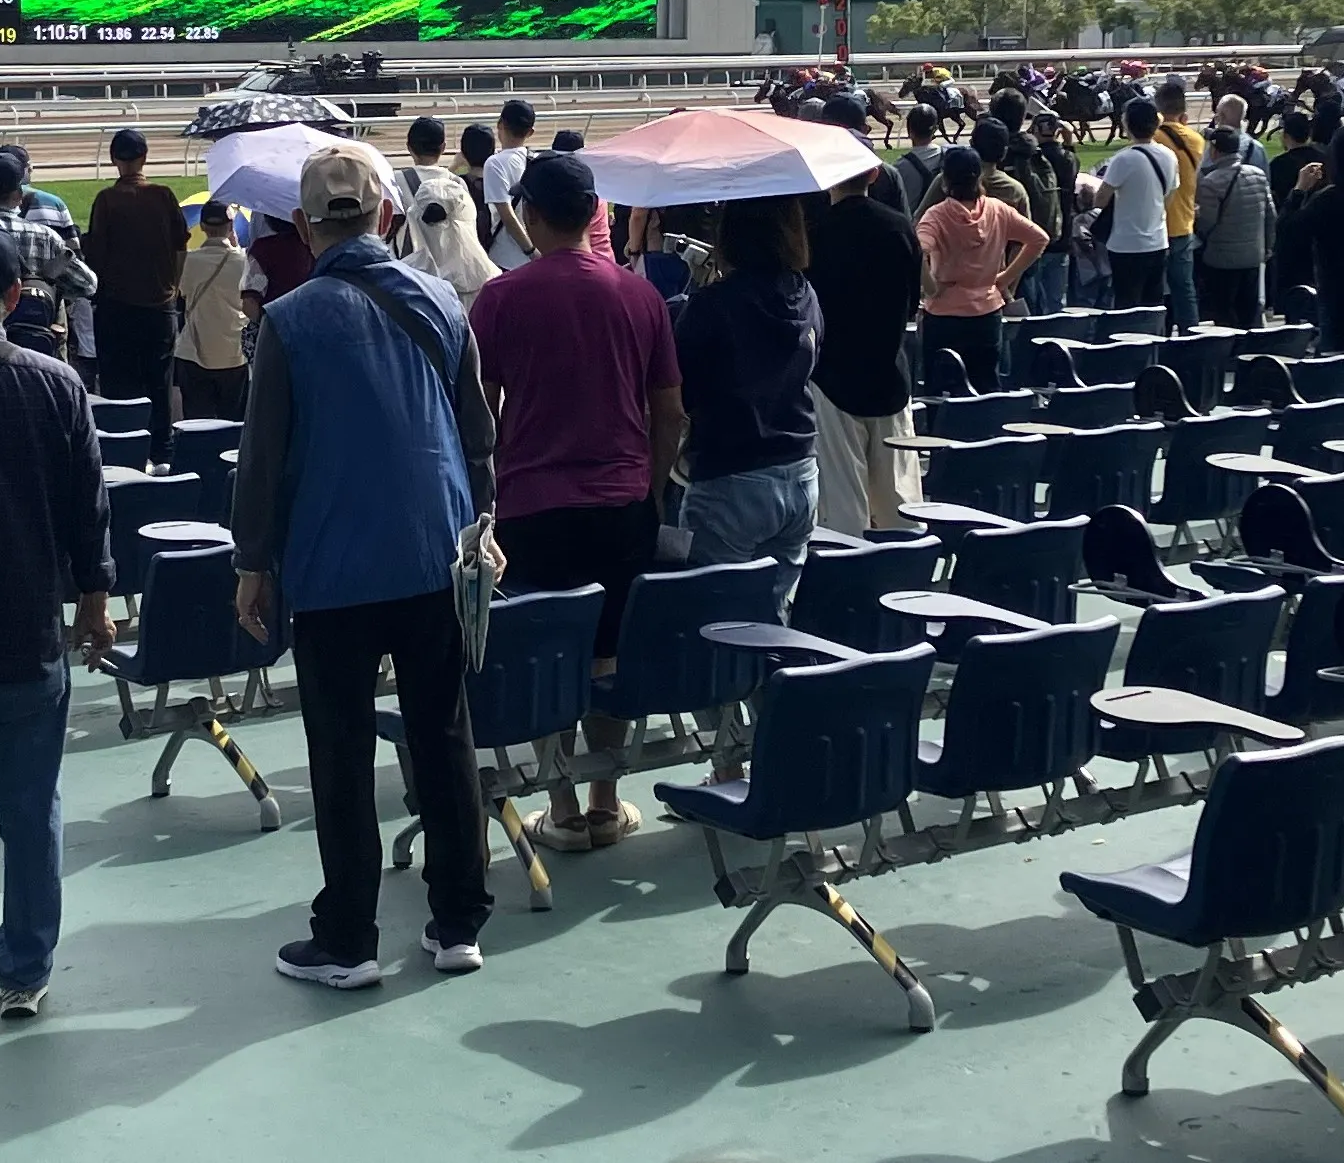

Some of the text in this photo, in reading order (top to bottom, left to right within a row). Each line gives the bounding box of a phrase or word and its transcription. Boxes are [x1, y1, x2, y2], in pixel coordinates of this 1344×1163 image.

[33, 24, 219, 40] 1:10.51 13.86 22.54 22.85
